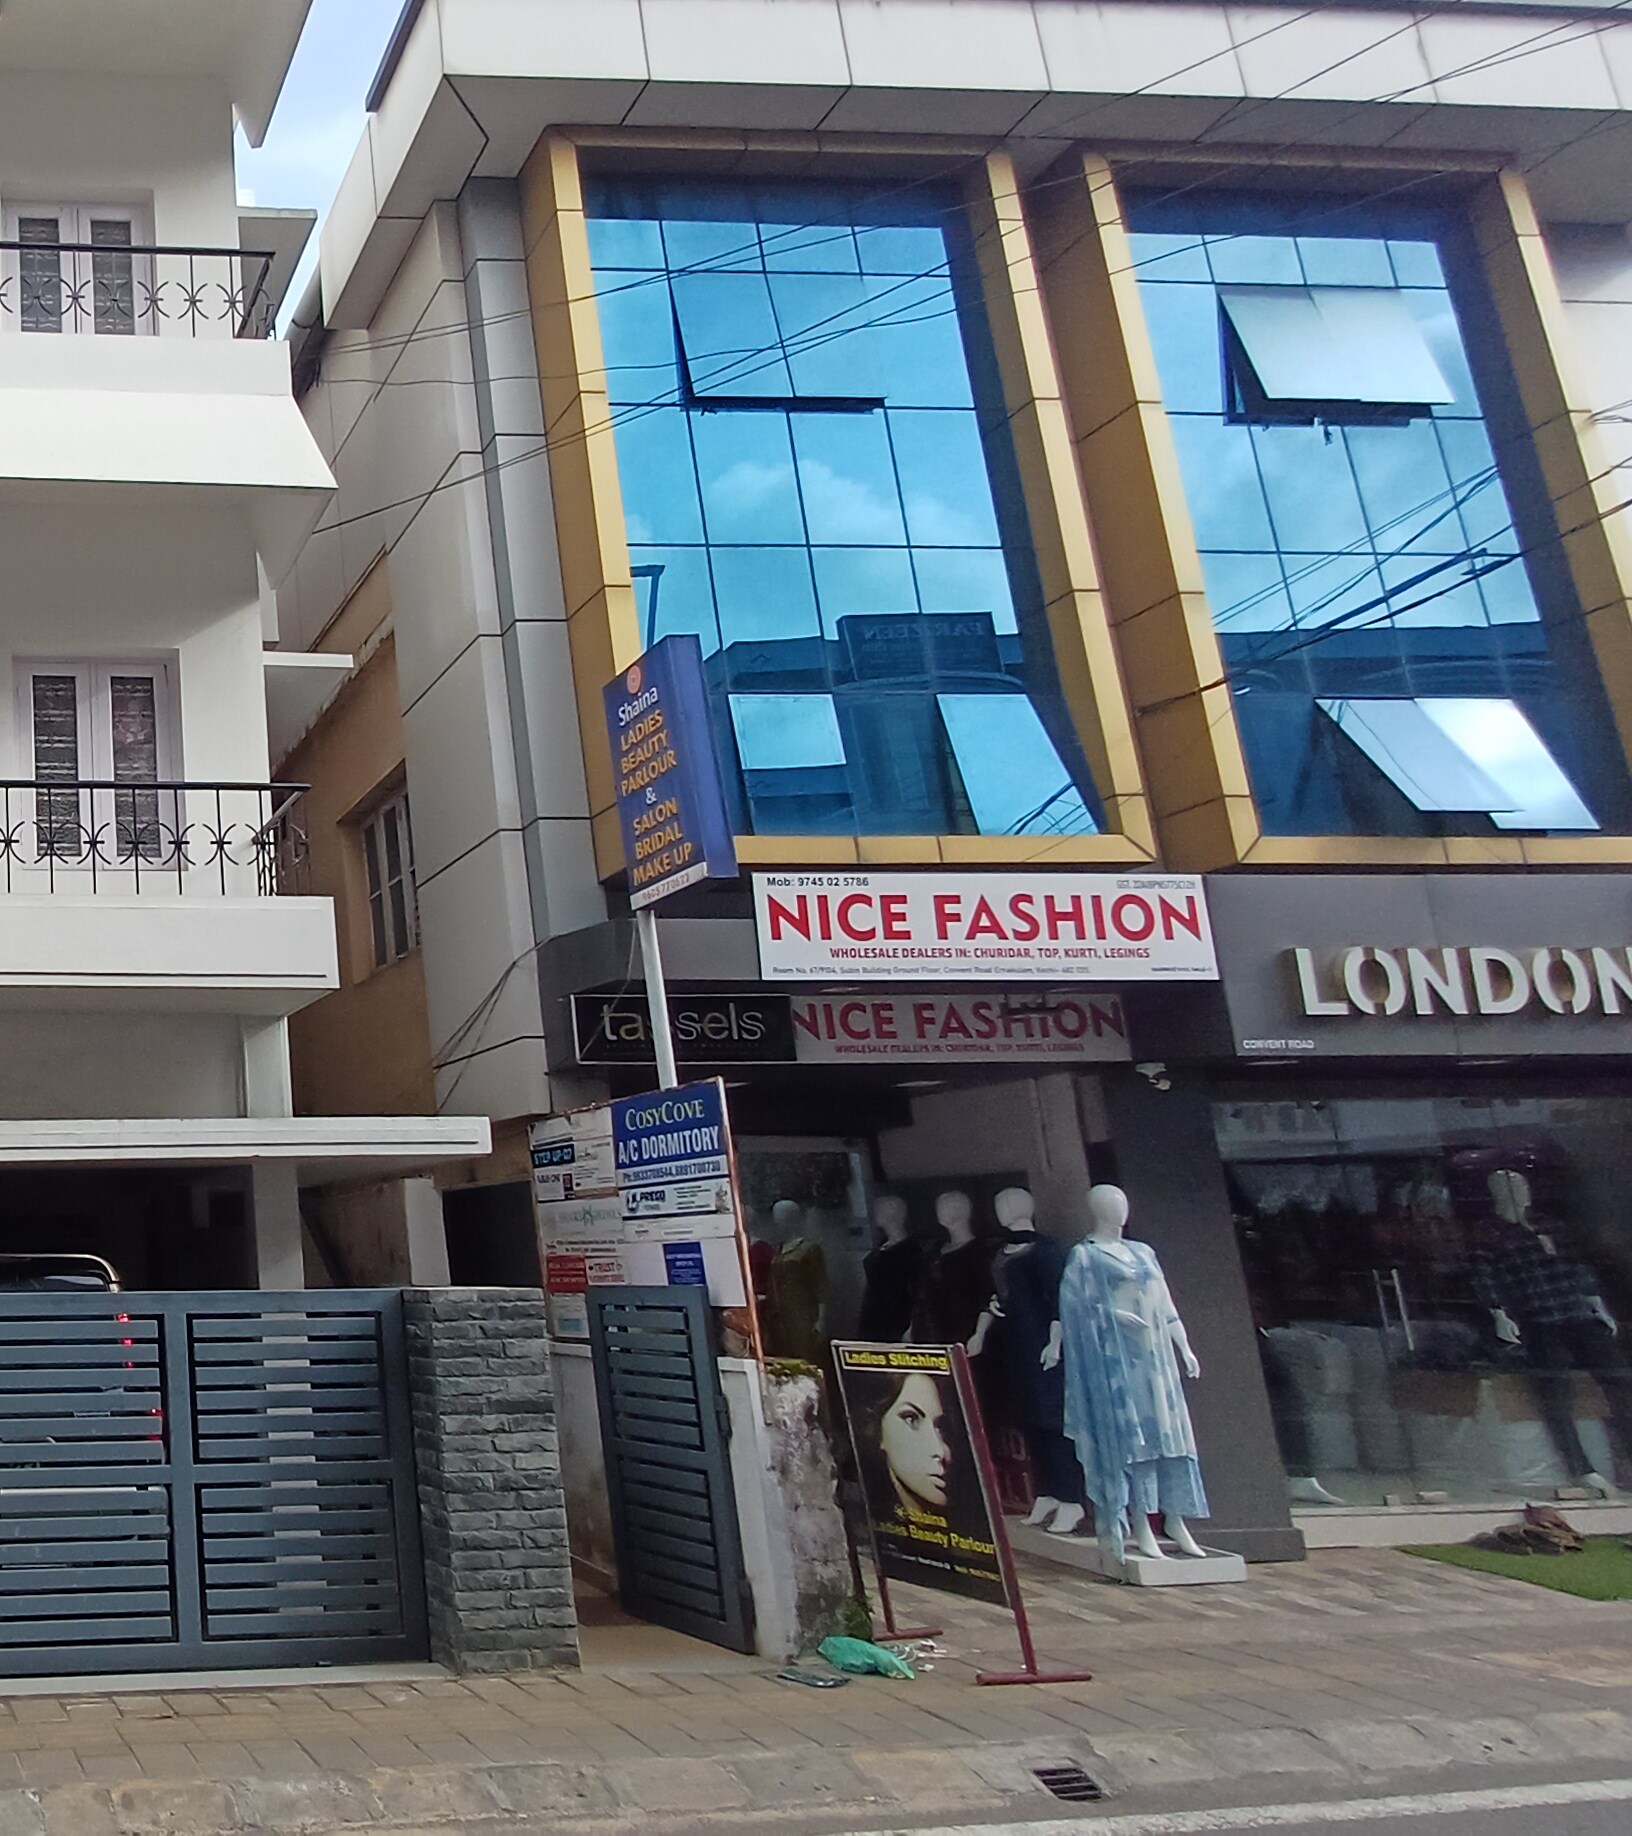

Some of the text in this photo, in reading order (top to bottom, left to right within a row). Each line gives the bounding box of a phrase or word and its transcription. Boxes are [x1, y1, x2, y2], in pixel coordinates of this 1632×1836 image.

[618, 687, 658, 726] Shaina
[621, 709, 664, 751] LADIES
[621, 729, 668, 774] BEAUTY
[621, 750, 677, 797] PARLOUR
[646, 787, 657, 804] &
[633, 797, 678, 836] SALON
[635, 822, 683, 860] BRIDAL
[633, 842, 692, 886] MAKE UP
[767, 877, 869, 887] Mob: 9745 02 5786
[767, 893, 1203, 942] NICE FASHION
[829, 947, 899, 958] WHOLESALE
[902, 947, 952, 958] DEALERS
[956, 947, 971, 958] IN:
[973, 947, 1035, 959] CHURIDAR,
[1037, 947, 1062, 959] TOP,
[1104, 947, 1150, 958] LEGINGS
[1293, 946, 1632, 1017] LONDON
[600, 1003, 766, 1041] tasels
[792, 1002, 898, 1041] NICE
[1242, 1039, 1286, 1049] CONVENT
[618, 1140, 639, 1166] A/C
[641, 1125, 720, 1162] DORMITORY
[845, 1351, 948, 1370] Ladies Stitching
[908, 1525, 949, 1549] Beauty
[950, 1532, 995, 1554] Parlour
